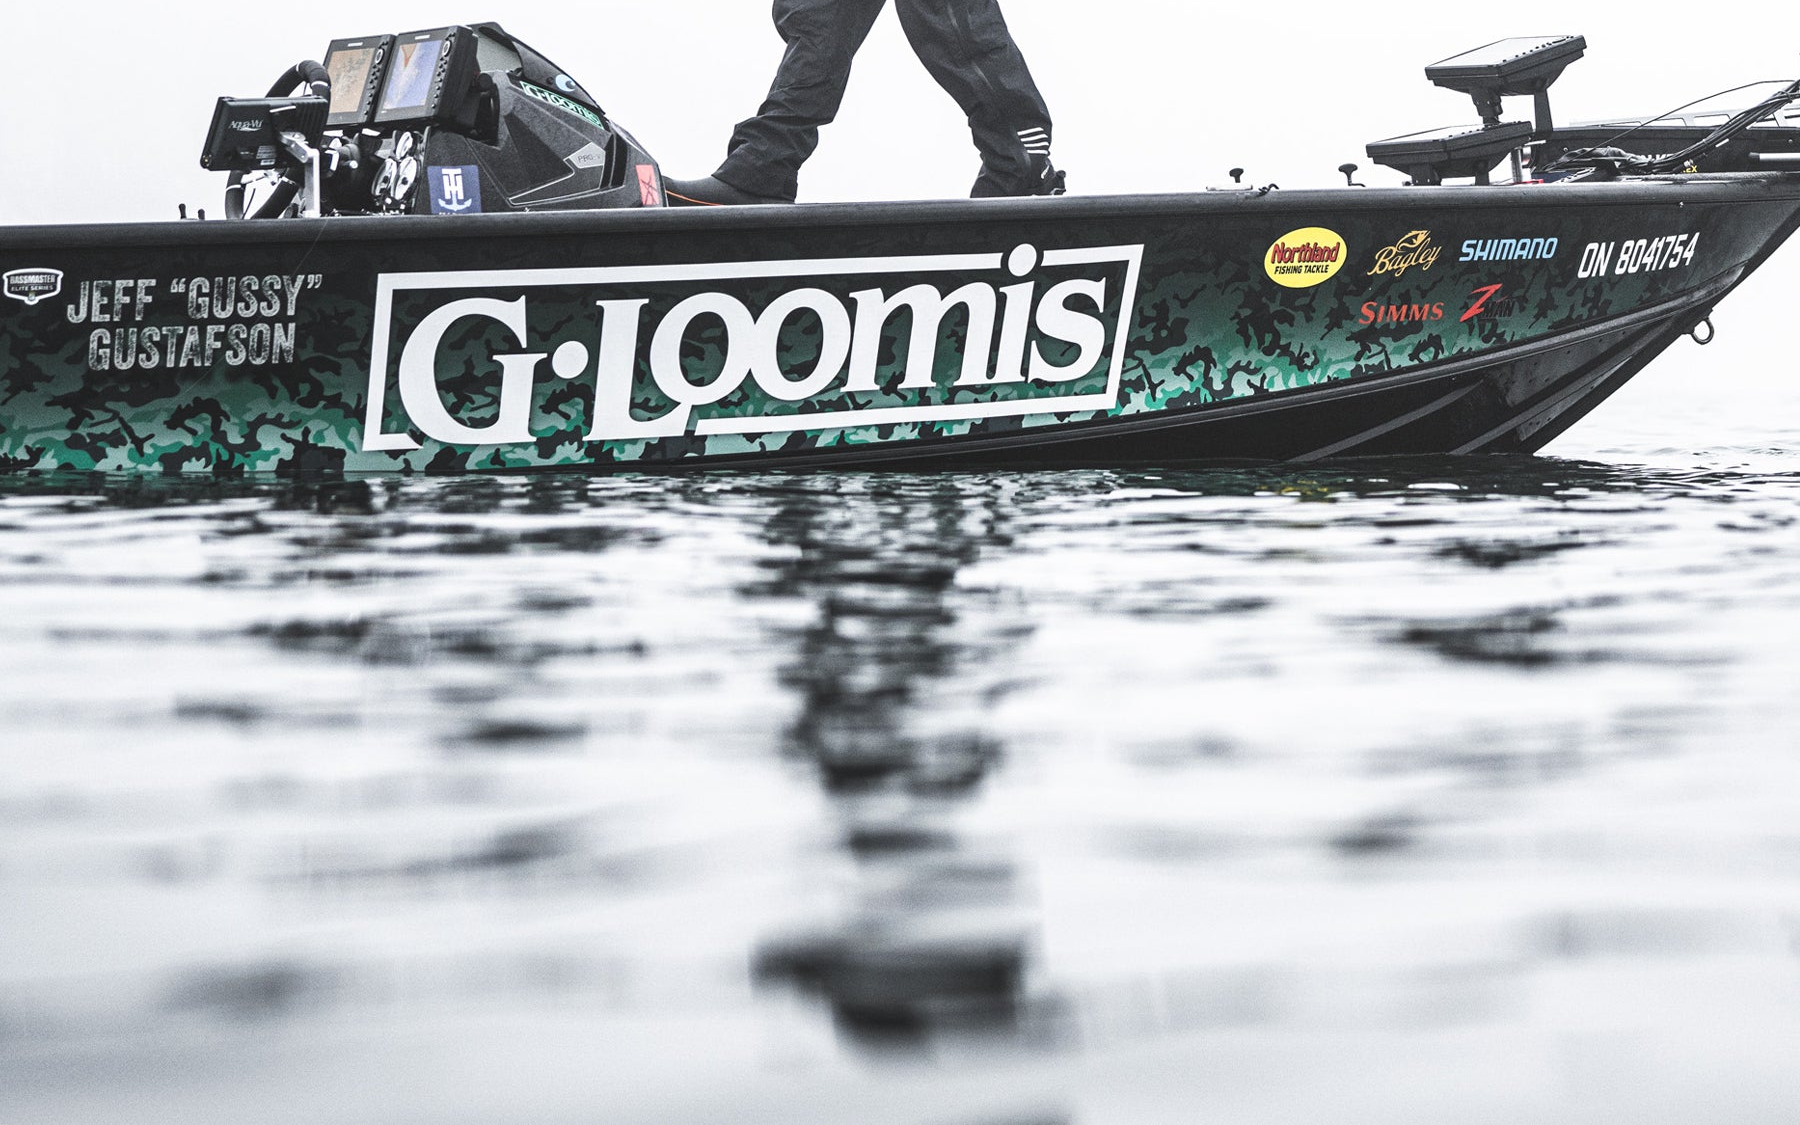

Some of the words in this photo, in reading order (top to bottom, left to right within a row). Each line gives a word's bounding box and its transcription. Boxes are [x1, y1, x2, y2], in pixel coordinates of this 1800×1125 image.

[1271, 241, 1341, 264] Northland
[1366, 236, 1443, 277] Bagley
[1458, 237, 1559, 262] SHIMANO
[1577, 241, 1616, 279] ON
[1614, 231, 1700, 275] 8041754
[10, 275, 56, 284] BASSMASTER
[1274, 265, 1302, 274] FISHING
[1304, 264, 1330, 274] TACKLE
[67, 279, 157, 323] JEFF
[1358, 301, 1445, 324] SIMMS
[88, 323, 296, 371] GUSTAFSON
